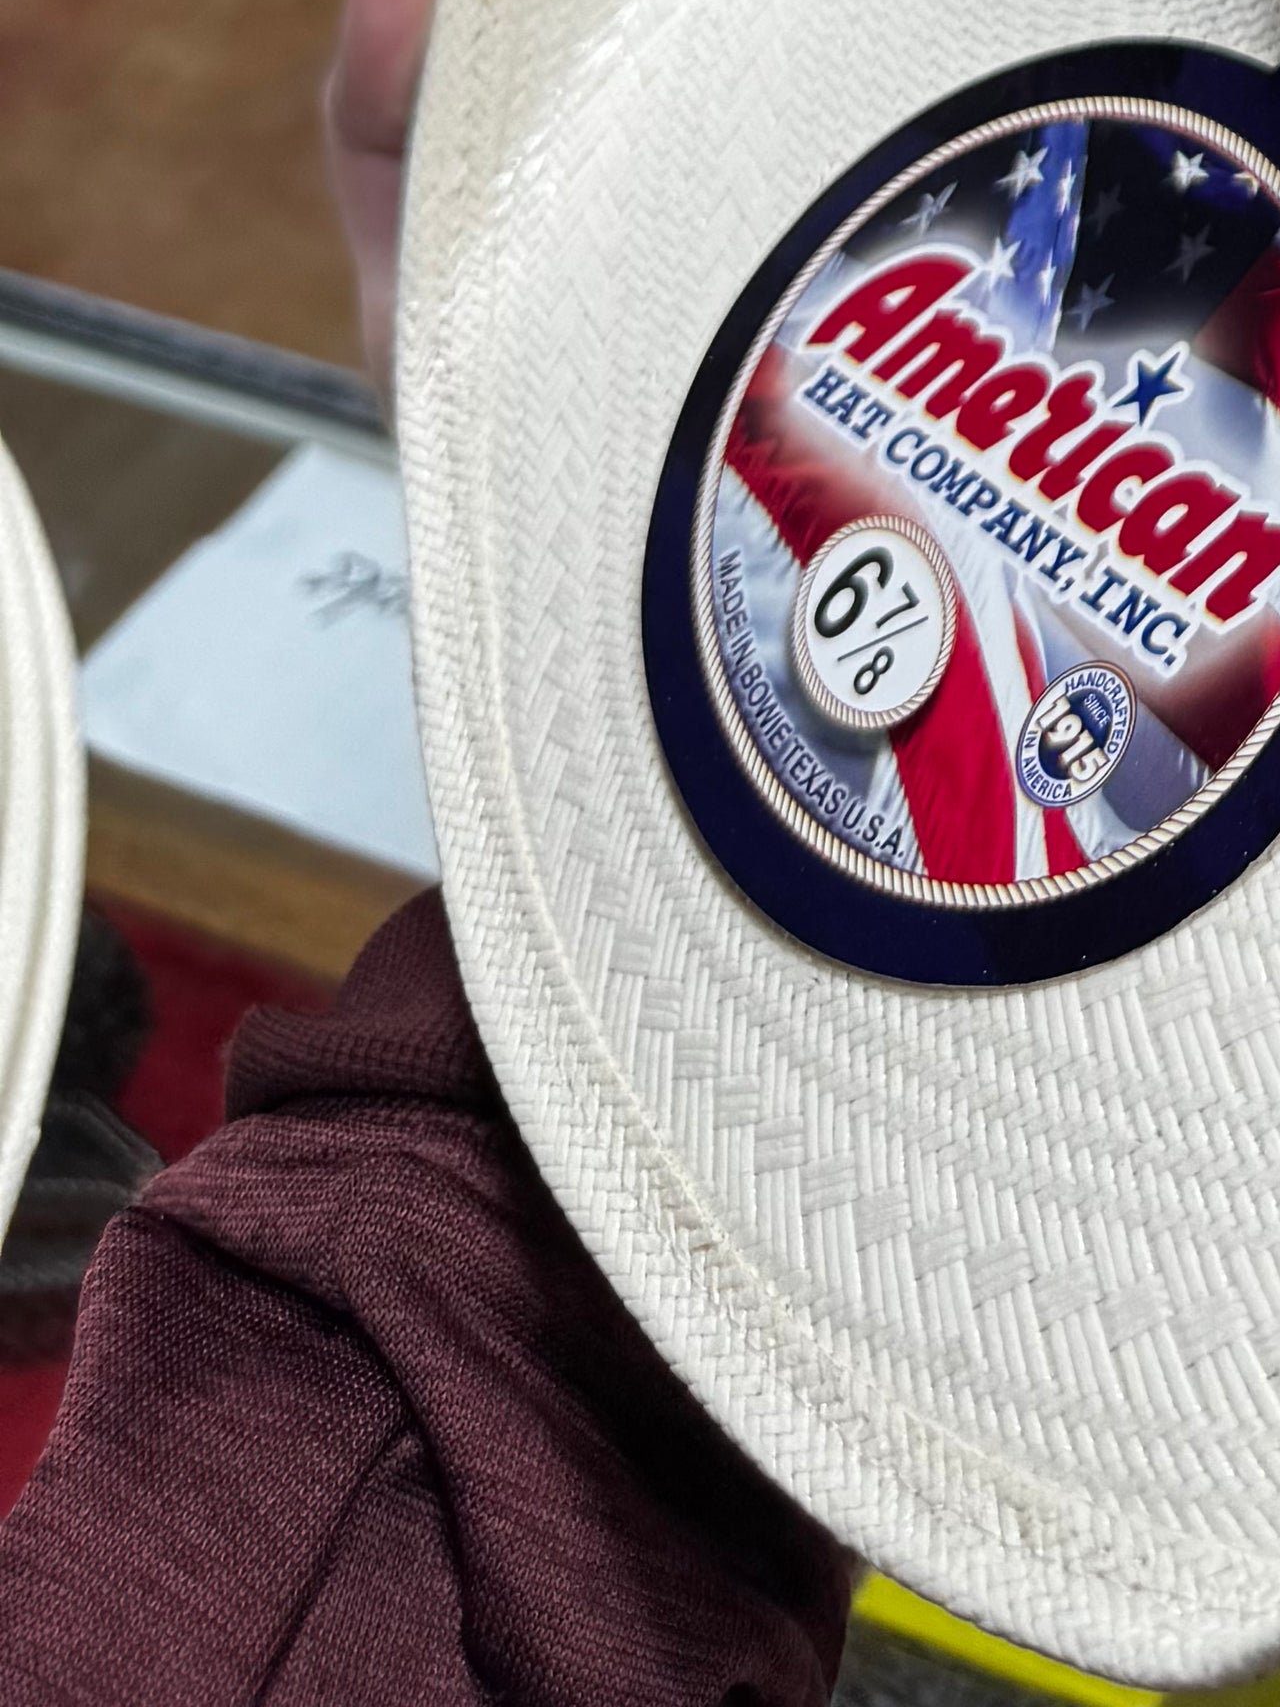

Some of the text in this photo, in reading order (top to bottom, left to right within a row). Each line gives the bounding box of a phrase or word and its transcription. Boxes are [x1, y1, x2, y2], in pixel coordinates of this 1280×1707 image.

[803, 365, 1190, 667] HAT COMPANY, INC.
[813, 546, 895, 639] 6
[718, 548, 905, 858] MADE IN BOWIE TEXAS U.S.A.
[1036, 695, 1111, 783] 1915
[1065, 670, 1129, 755] HANDCRAFTED
[1083, 693, 1111, 729] SINCE
[1022, 730, 1073, 800] IN AMERICA
